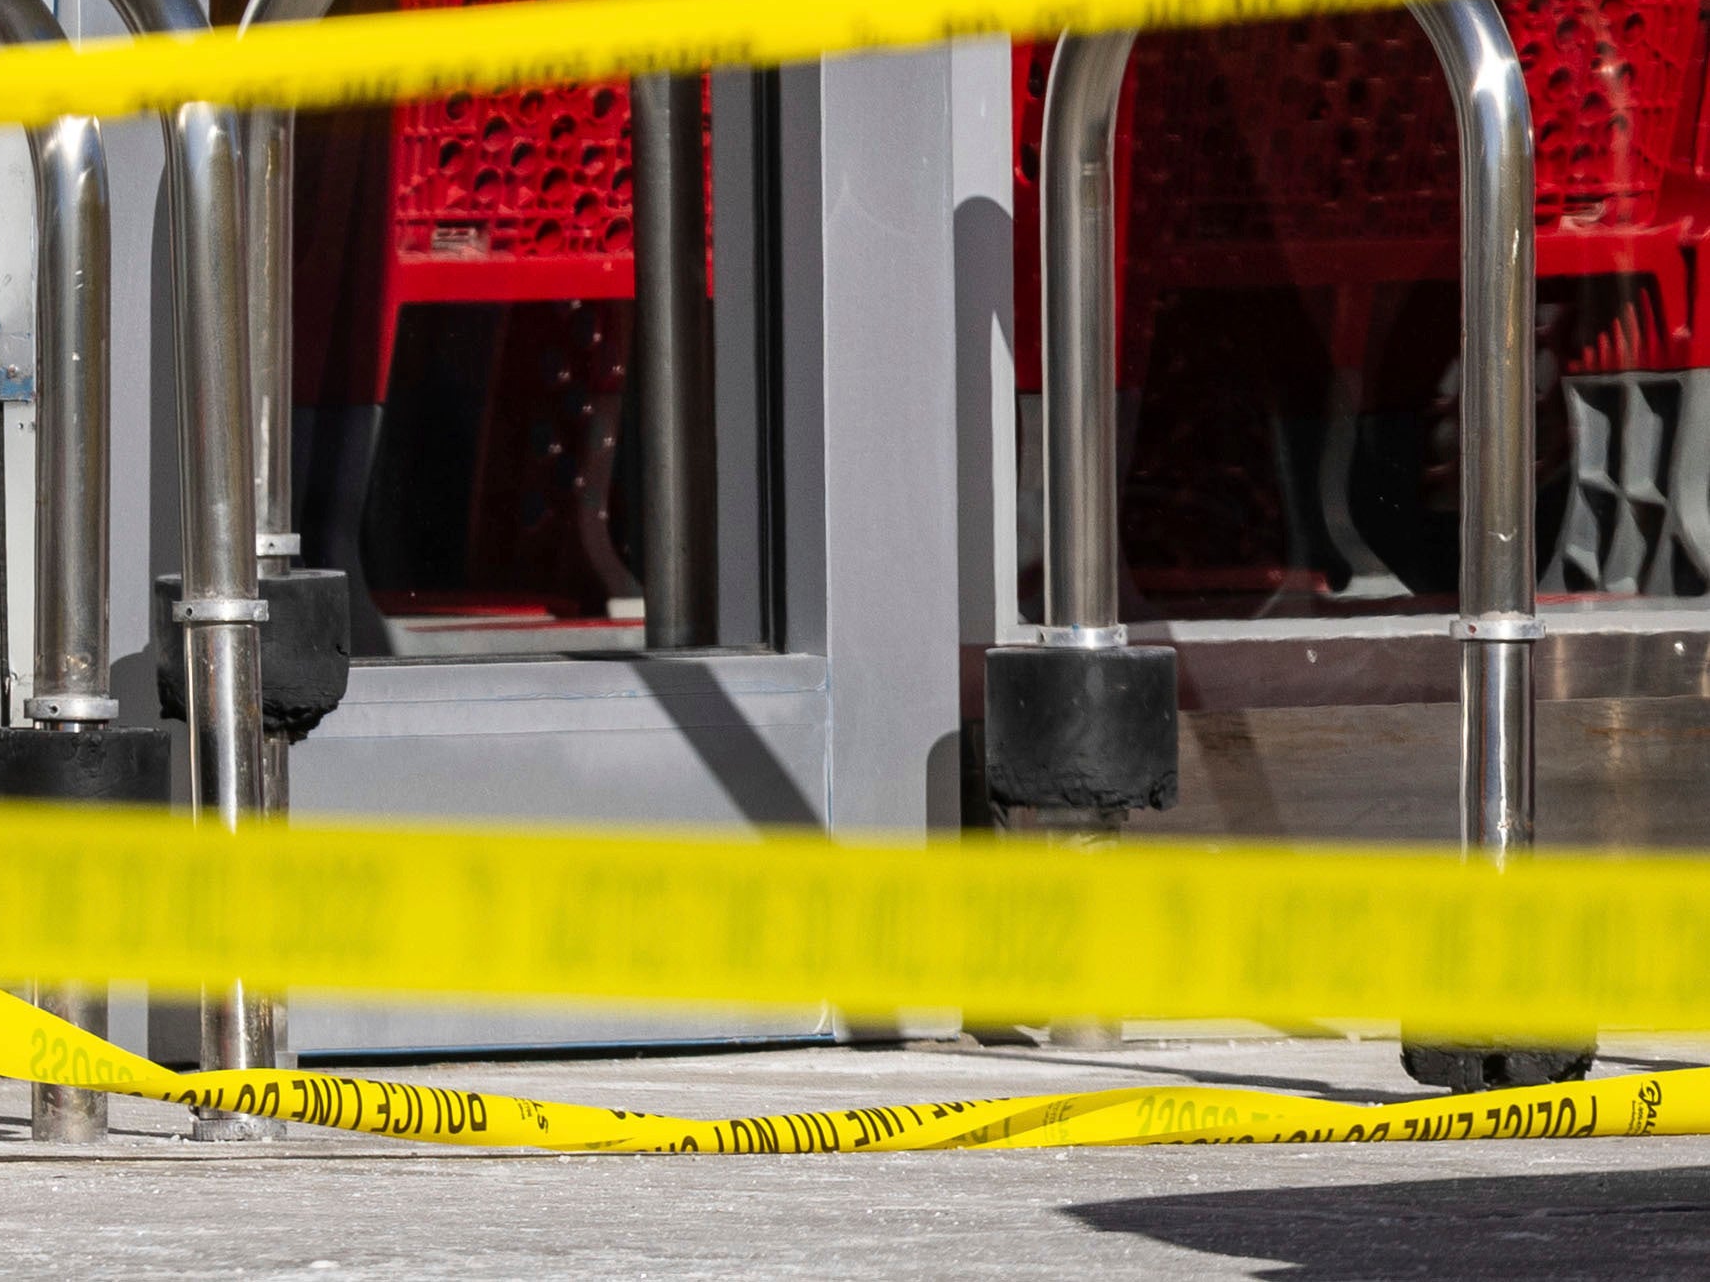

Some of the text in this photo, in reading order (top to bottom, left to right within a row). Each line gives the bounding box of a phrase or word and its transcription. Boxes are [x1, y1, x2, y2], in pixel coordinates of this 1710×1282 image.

[292, 1078, 363, 1130] LINE
[372, 1081, 486, 1135] POLICE
[1486, 1096, 1597, 1139] POLICE
